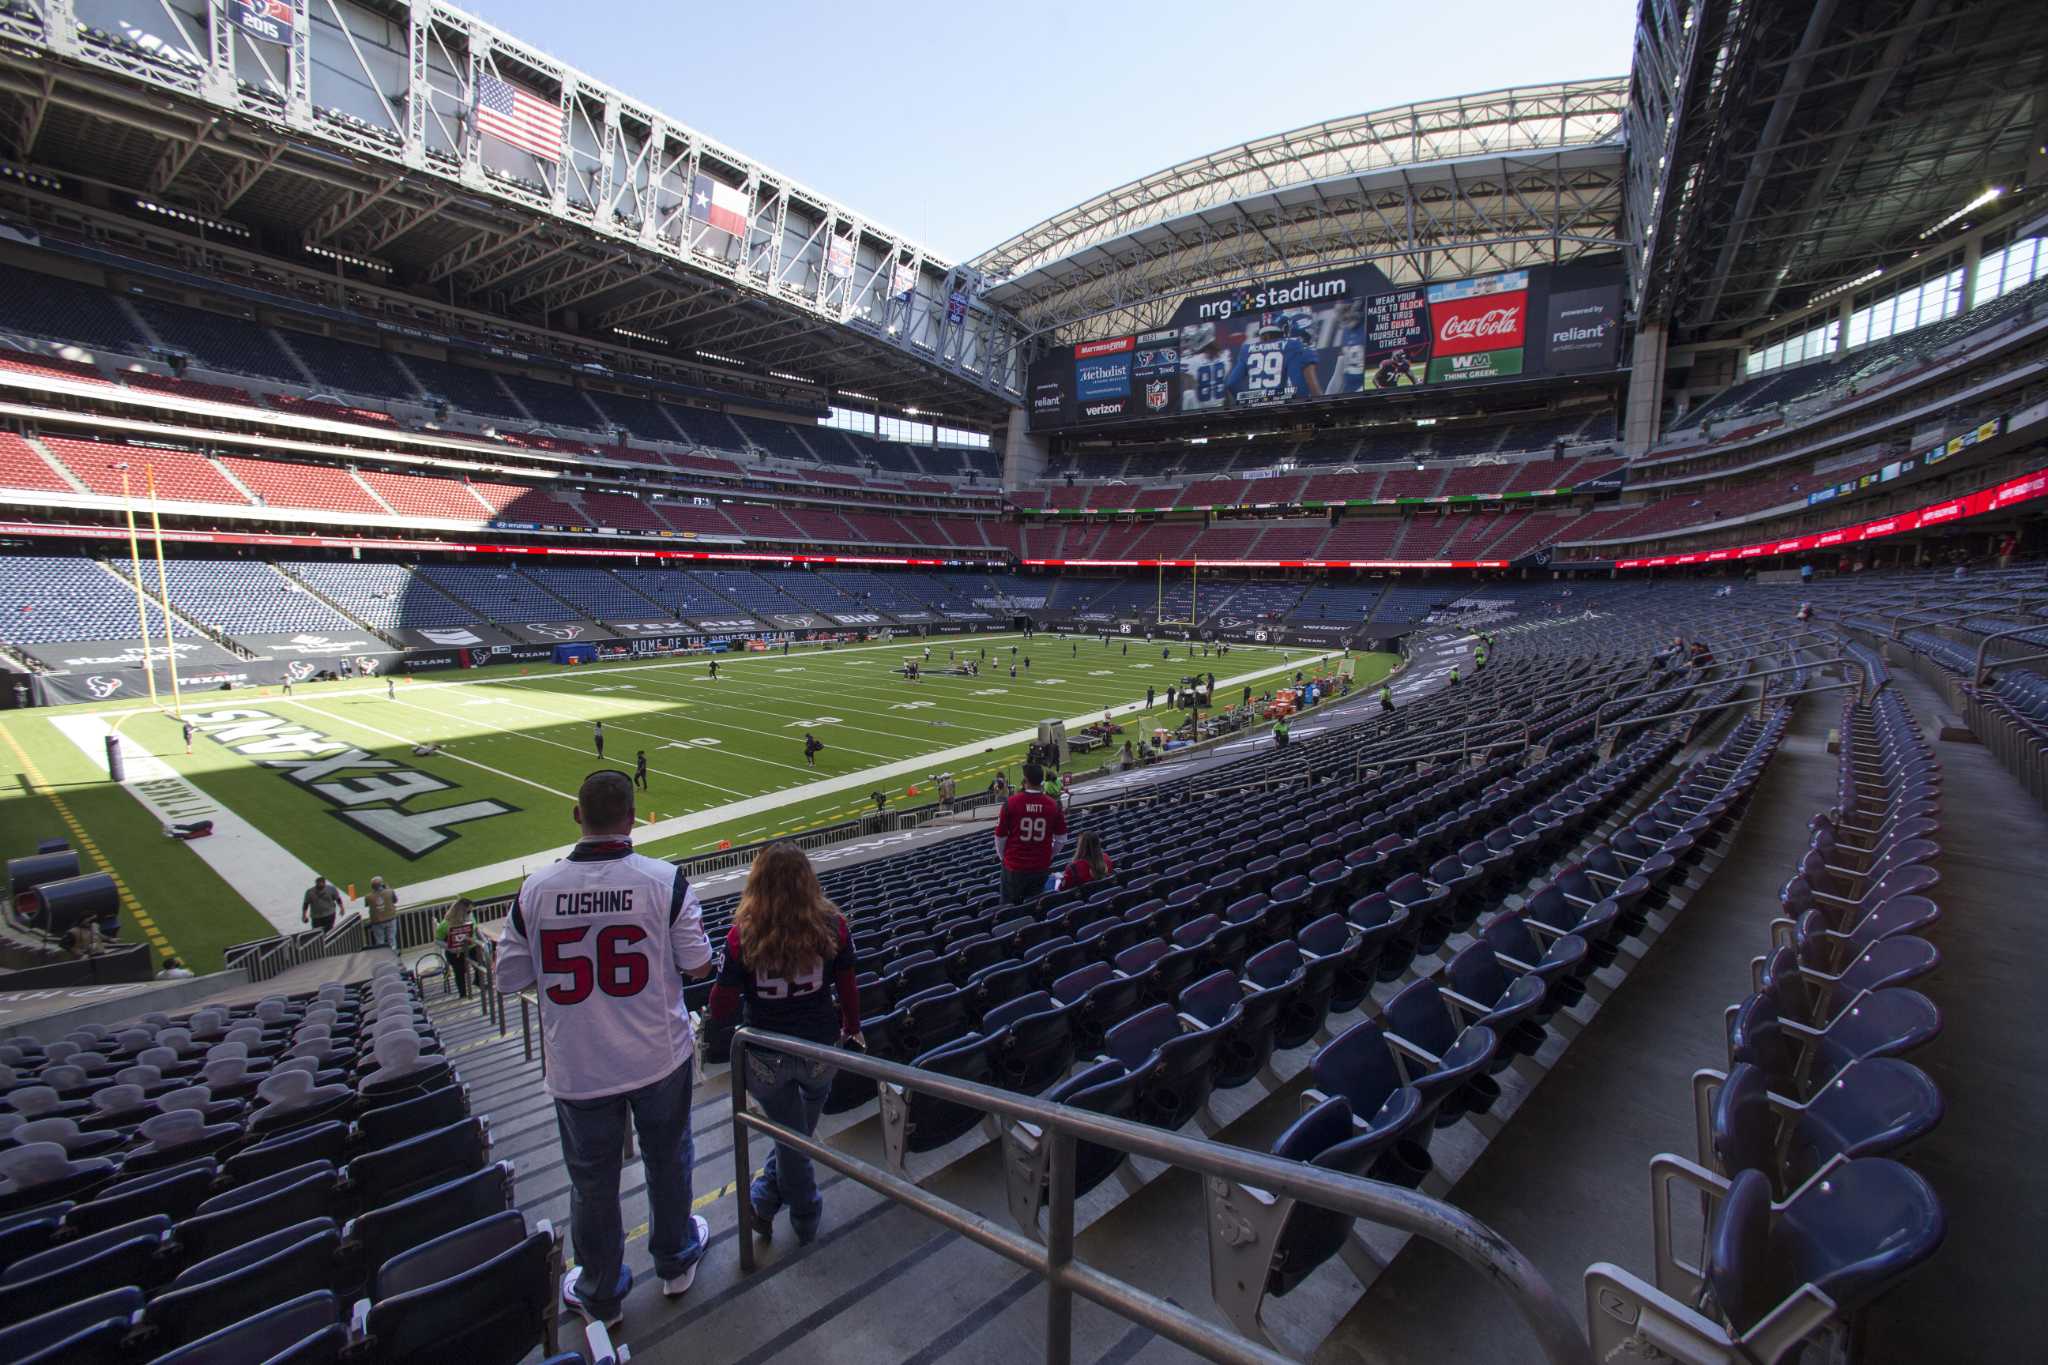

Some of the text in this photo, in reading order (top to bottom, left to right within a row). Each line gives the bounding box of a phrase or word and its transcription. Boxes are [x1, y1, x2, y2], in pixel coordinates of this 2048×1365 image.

[242, 12, 280, 39] 2015
[1200, 279, 1346, 319] nrg stadium
[1375, 291, 1416, 306] WEAR YOUR
[1368, 299, 1424, 315] MASK TO BLOCK
[1377, 310, 1413, 322] THE VIRUS
[1375, 319, 1415, 332] AND GUARD
[1369, 326, 1420, 340] YOURSELF AND
[1553, 325, 1604, 342] reliant
[1080, 365, 1127, 382] Methodist
[1247, 351, 1284, 389] 29
[1444, 372, 1468, 381] THINK
[1197, 361, 1226, 402] 88
[1035, 395, 1060, 407] reliant
[1086, 403, 1121, 416] verizon
[833, 614, 880, 623] BHP
[632, 640, 662, 652] HOME
[668, 639, 680, 649] OF
[687, 637, 705, 647] THE
[64, 652, 188, 665] stadium
[404, 658, 452, 668] TEXANS
[178, 673, 248, 685] TEXANS
[784, 716, 844, 728] 20
[656, 737, 722, 749] 10
[172, 708, 516, 857] TEXANS
[1026, 803, 1043, 813] WATT
[1020, 817, 1047, 841] 99
[556, 889, 633, 916] CUSHING
[540, 924, 649, 1005] 56
